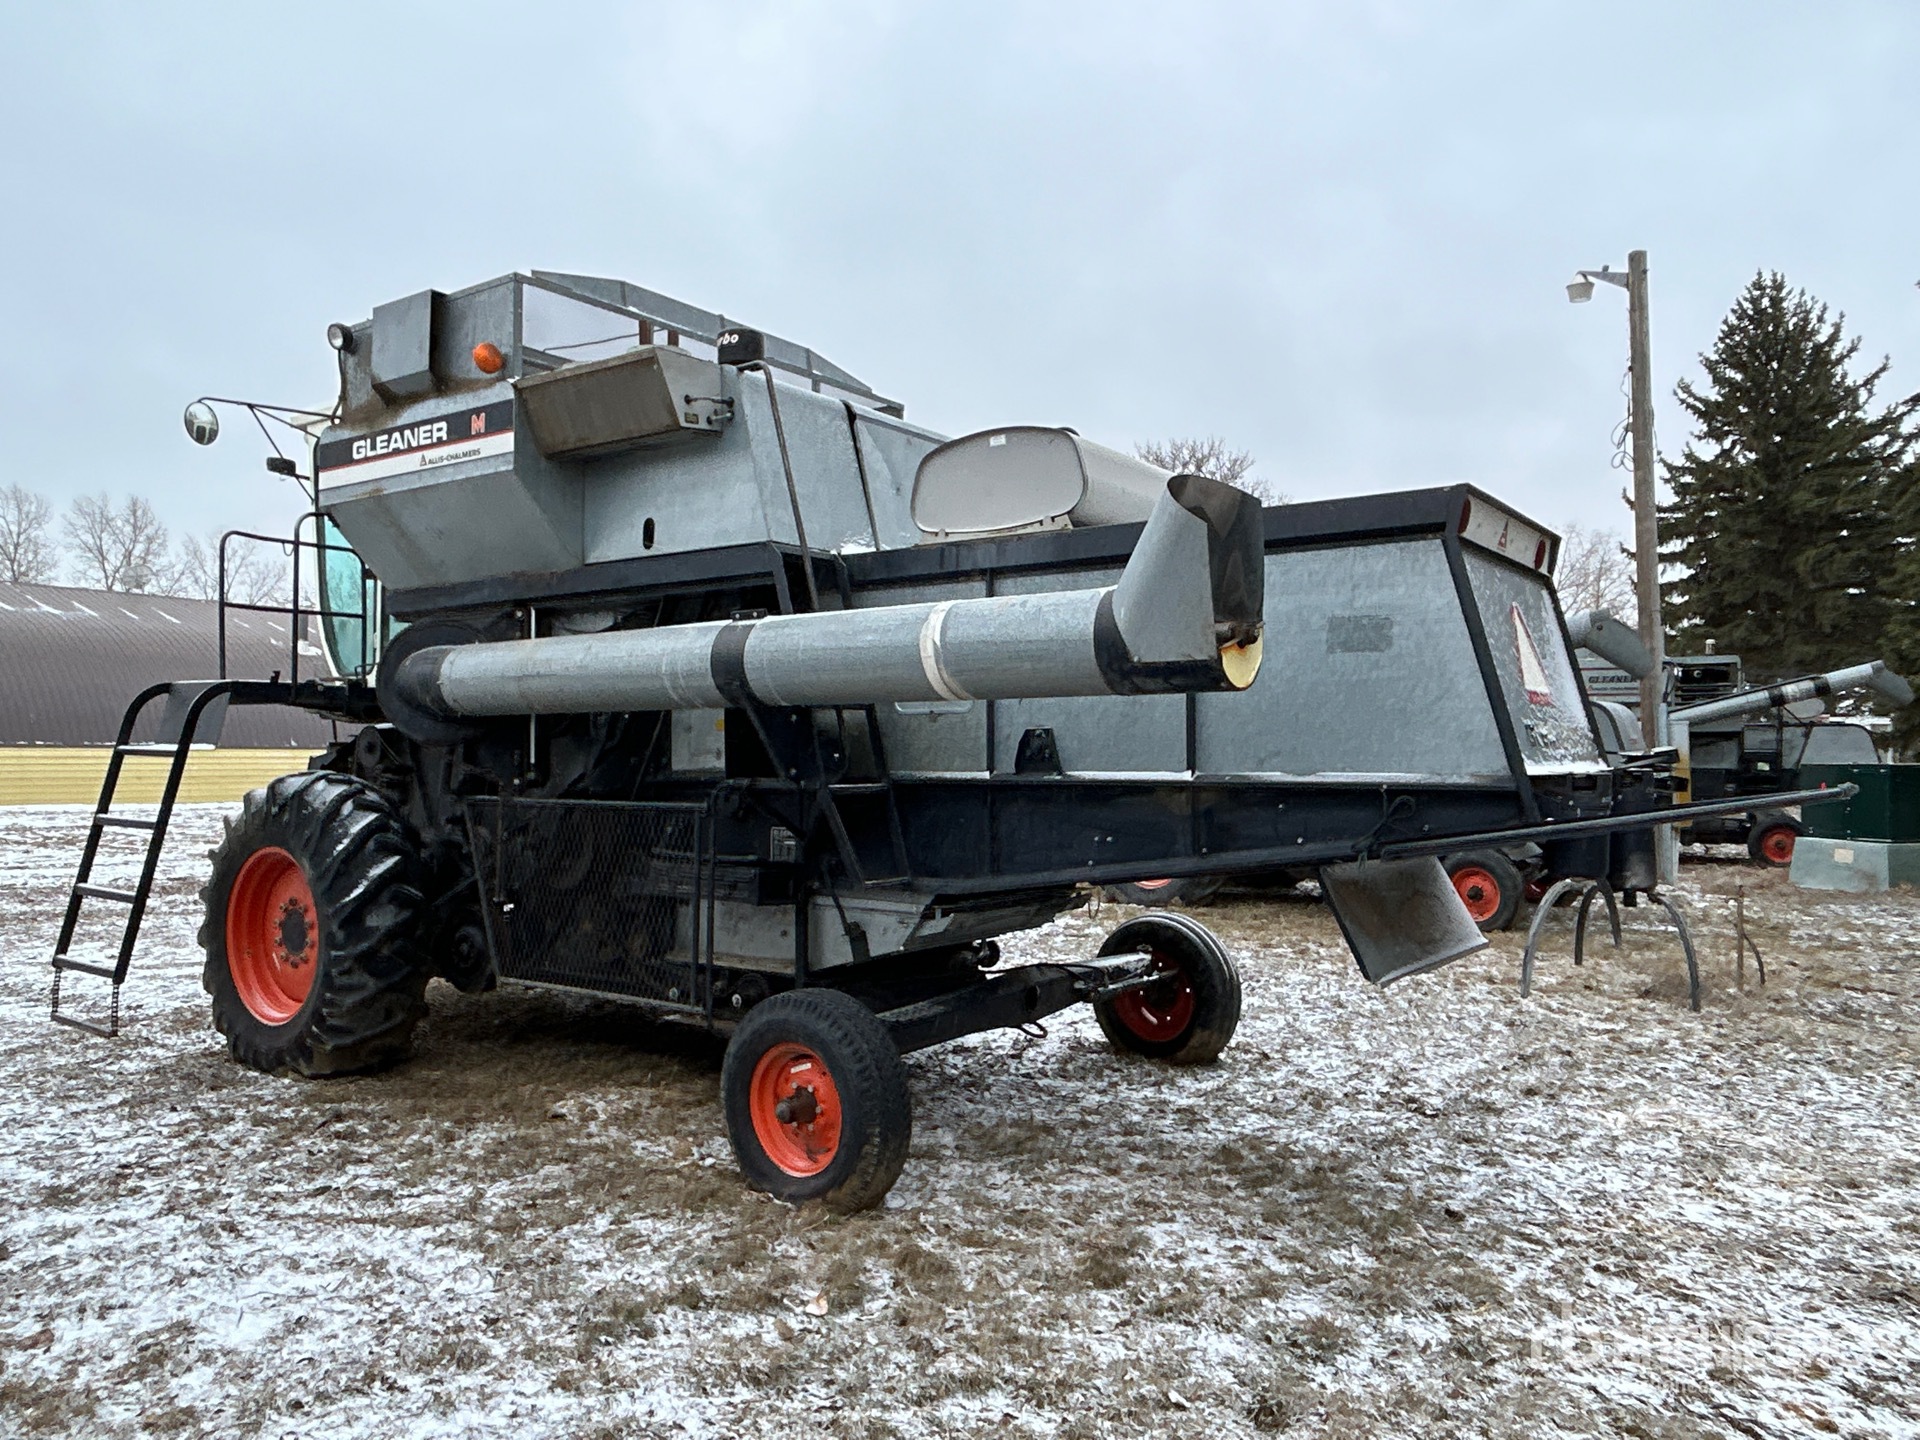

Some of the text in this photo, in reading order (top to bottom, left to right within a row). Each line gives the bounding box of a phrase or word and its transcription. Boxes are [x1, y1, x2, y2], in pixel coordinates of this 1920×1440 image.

[352, 412, 486, 460] GLEANER M
[428, 448, 481, 464] ALLIS-CHALMERS
